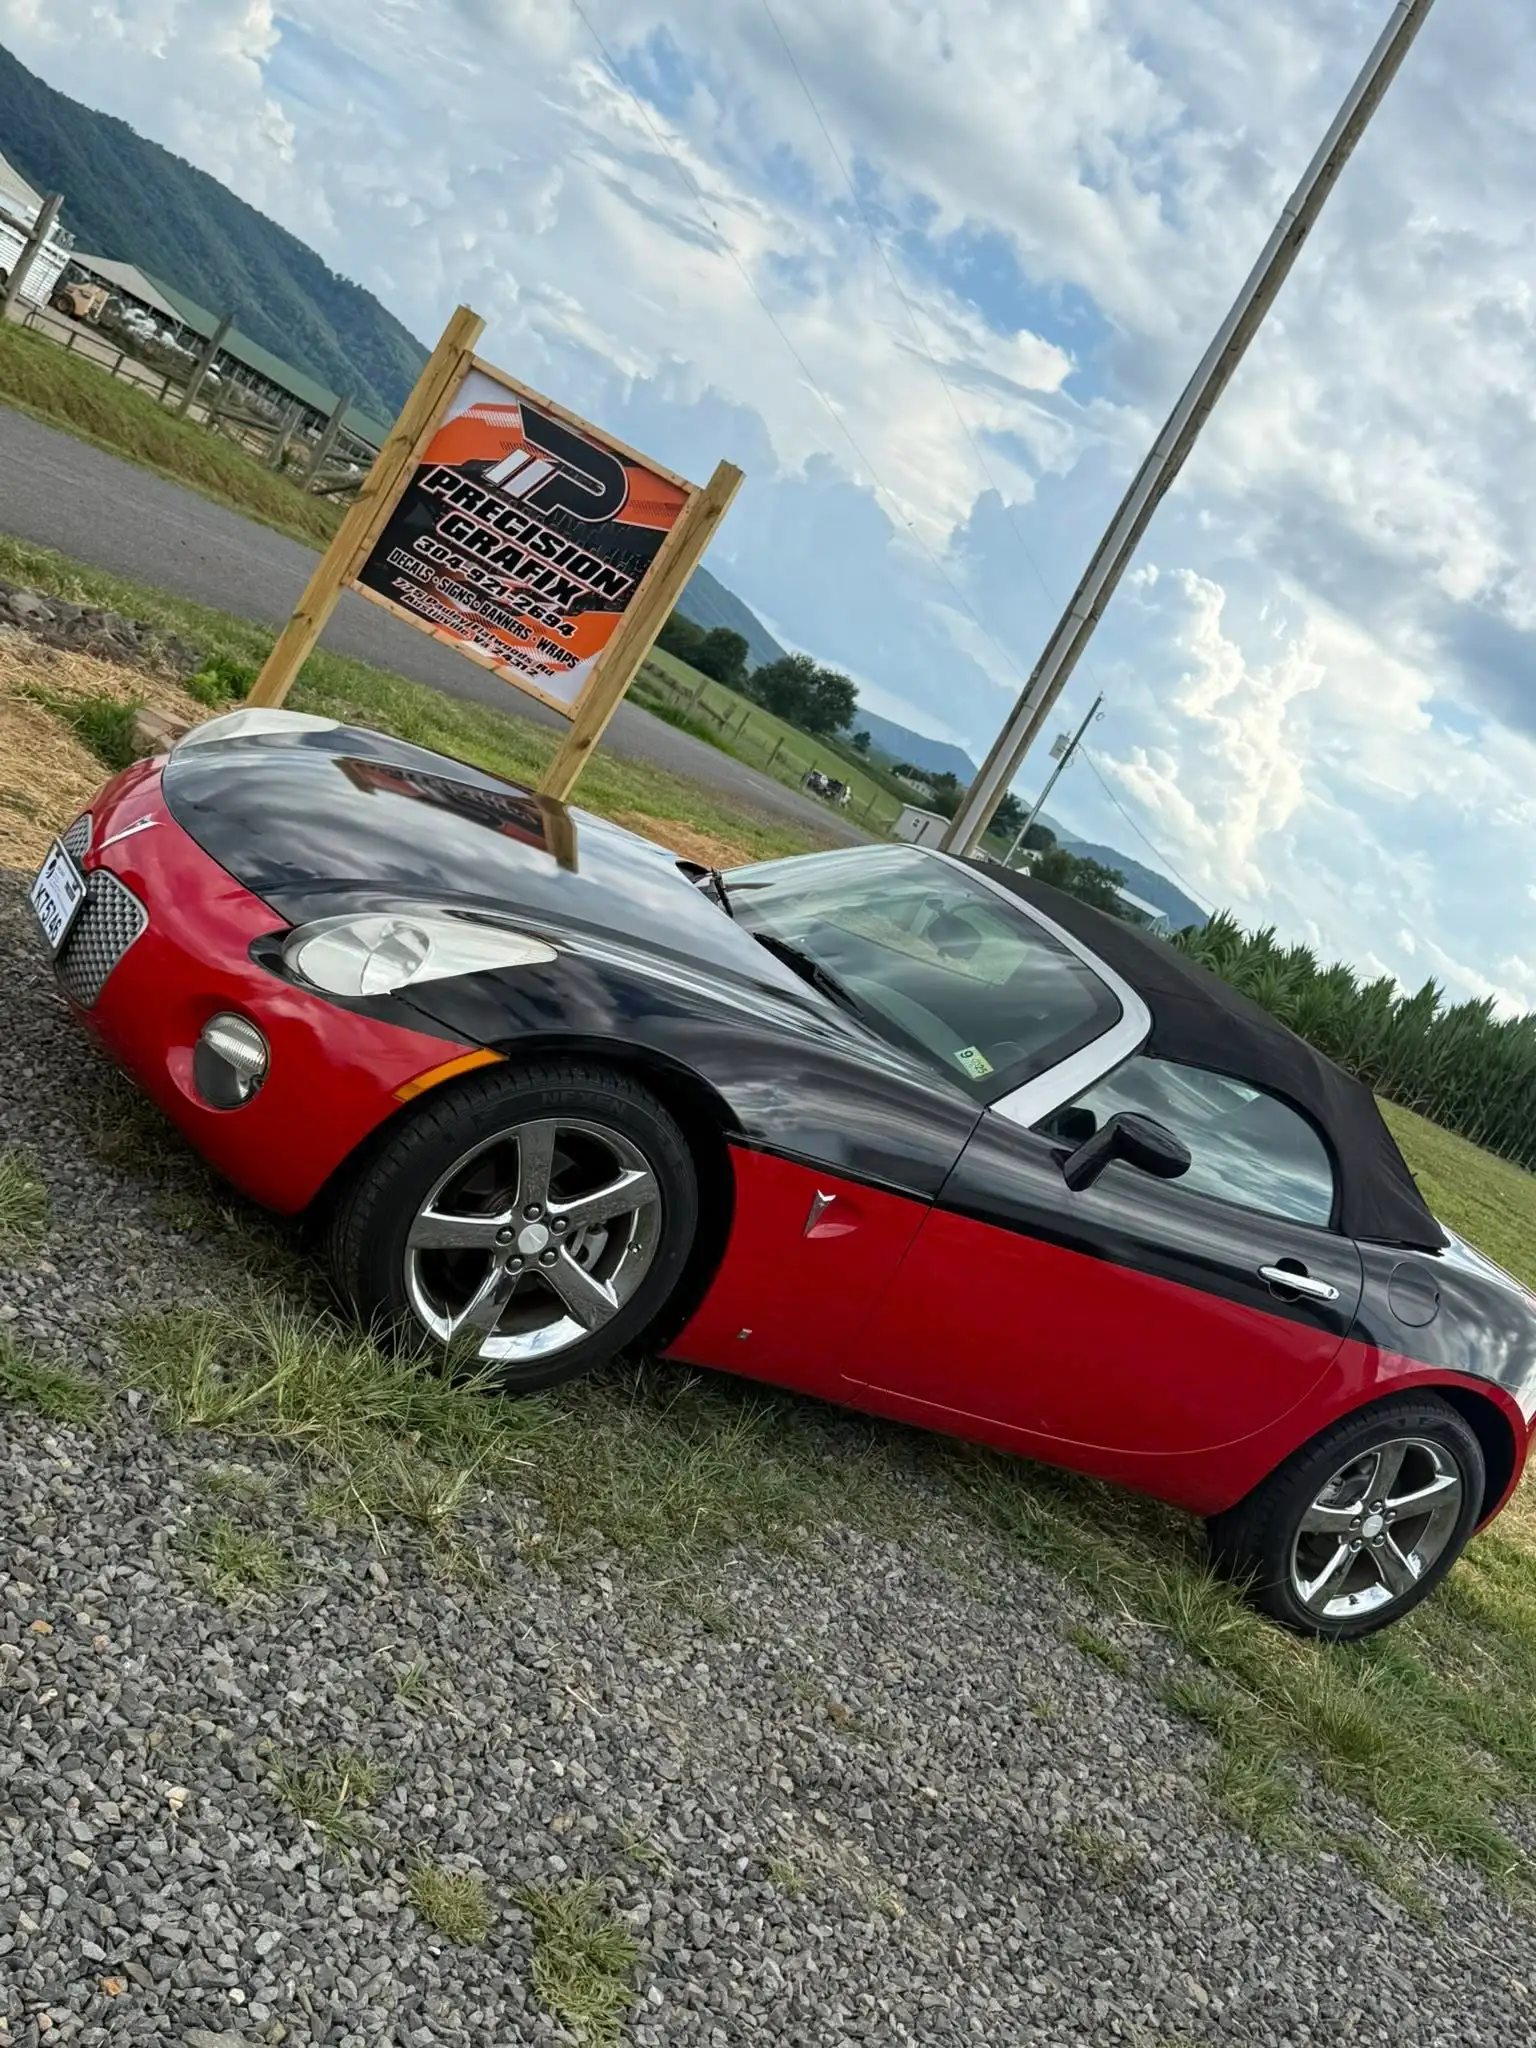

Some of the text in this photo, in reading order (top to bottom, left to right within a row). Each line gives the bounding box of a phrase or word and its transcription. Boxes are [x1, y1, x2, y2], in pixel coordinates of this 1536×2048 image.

[418, 463, 634, 601] PRECISION
[434, 508, 589, 610] GRAFIX
[386, 547, 579, 669] DECALS SIGNS BANNERS WRAPS
[412, 534, 577, 638] 304-921-2694
[473, 635, 489, 649] Va
[491, 646, 539, 677] 24312
[541, 1092, 627, 1113] NEXEN
[960, 1050, 974, 1059] 9
